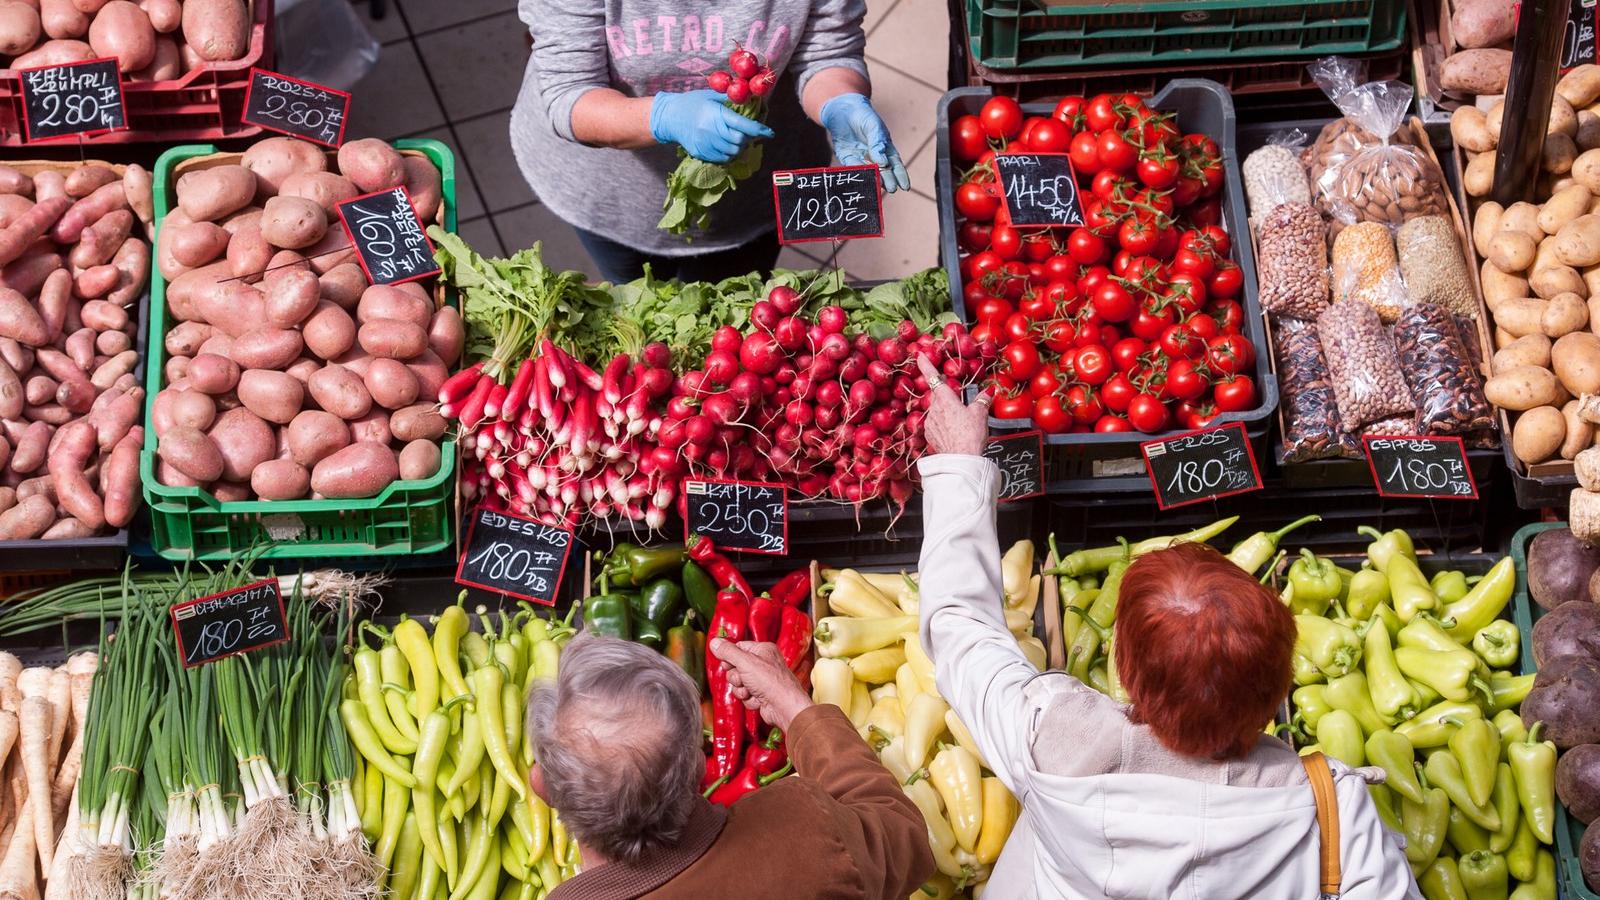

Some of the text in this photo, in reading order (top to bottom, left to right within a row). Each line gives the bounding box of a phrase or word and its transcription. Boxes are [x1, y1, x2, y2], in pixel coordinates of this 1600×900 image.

[606, 16, 724, 60] RETRO
[37, 94, 98, 127] 280
[257, 95, 324, 128] 280
[1006, 174, 1075, 209] 1450
[785, 195, 844, 231] 120
[352, 205, 395, 257] 160
[1167, 459, 1224, 494] 180
[1386, 458, 1448, 491] 180
[1449, 480, 1472, 495] DB
[697, 502, 769, 536] 250
[758, 533, 785, 553] DB
[469, 541, 531, 581] 180
[524, 571, 547, 592] DB
[187, 619, 243, 663] 180
